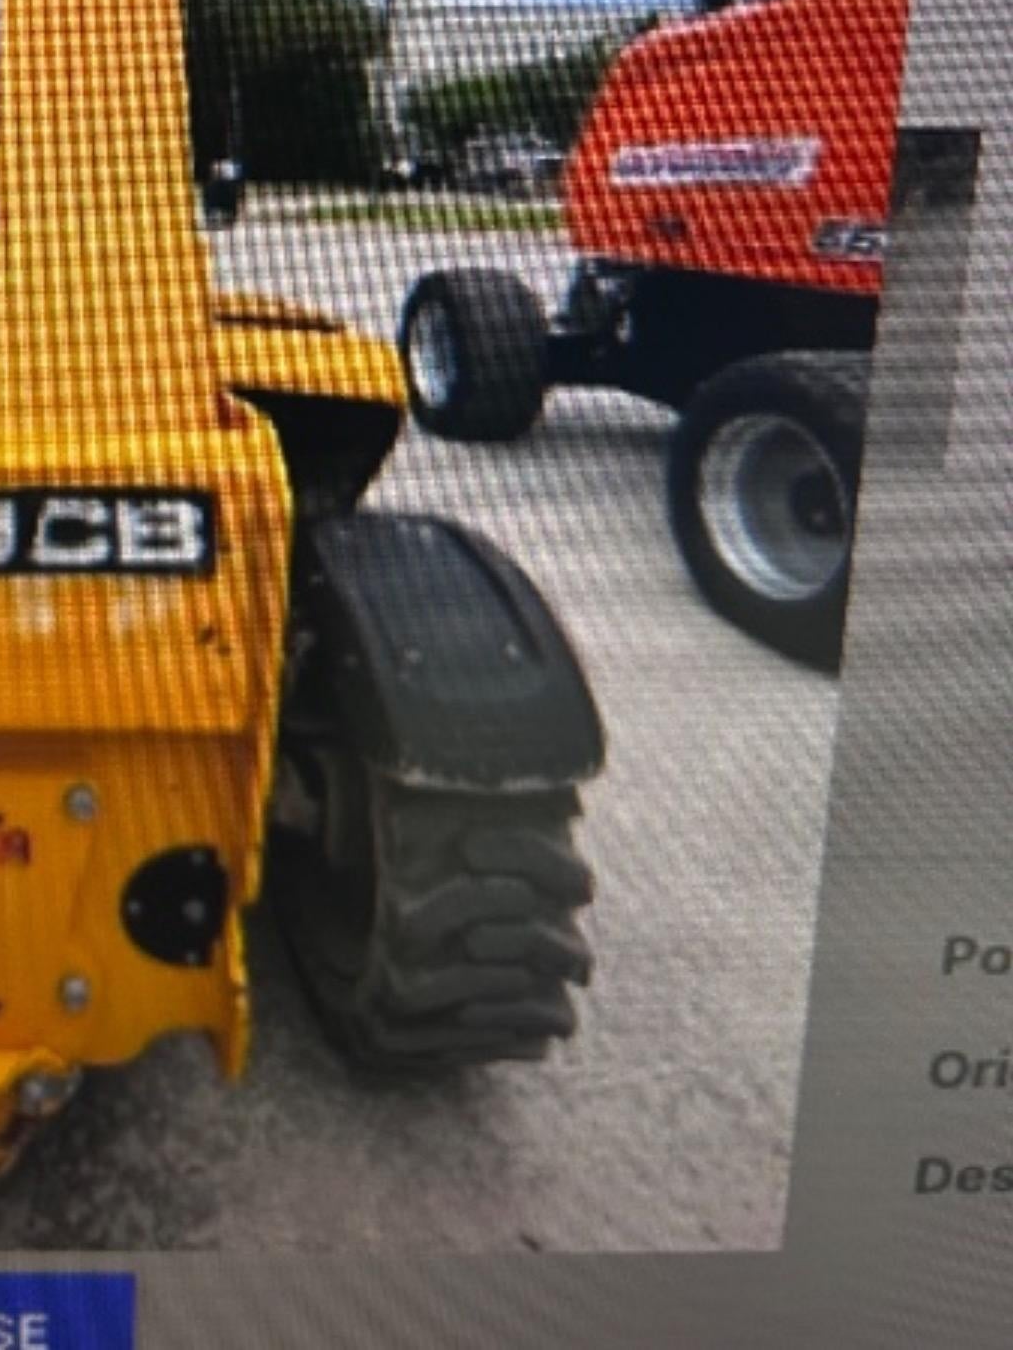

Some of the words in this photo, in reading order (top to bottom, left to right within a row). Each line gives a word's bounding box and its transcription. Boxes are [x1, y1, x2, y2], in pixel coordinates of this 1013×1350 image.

[941, 935, 1012, 976] Po
[928, 1046, 1013, 1090] Ori
[913, 1156, 1013, 1195] Des
